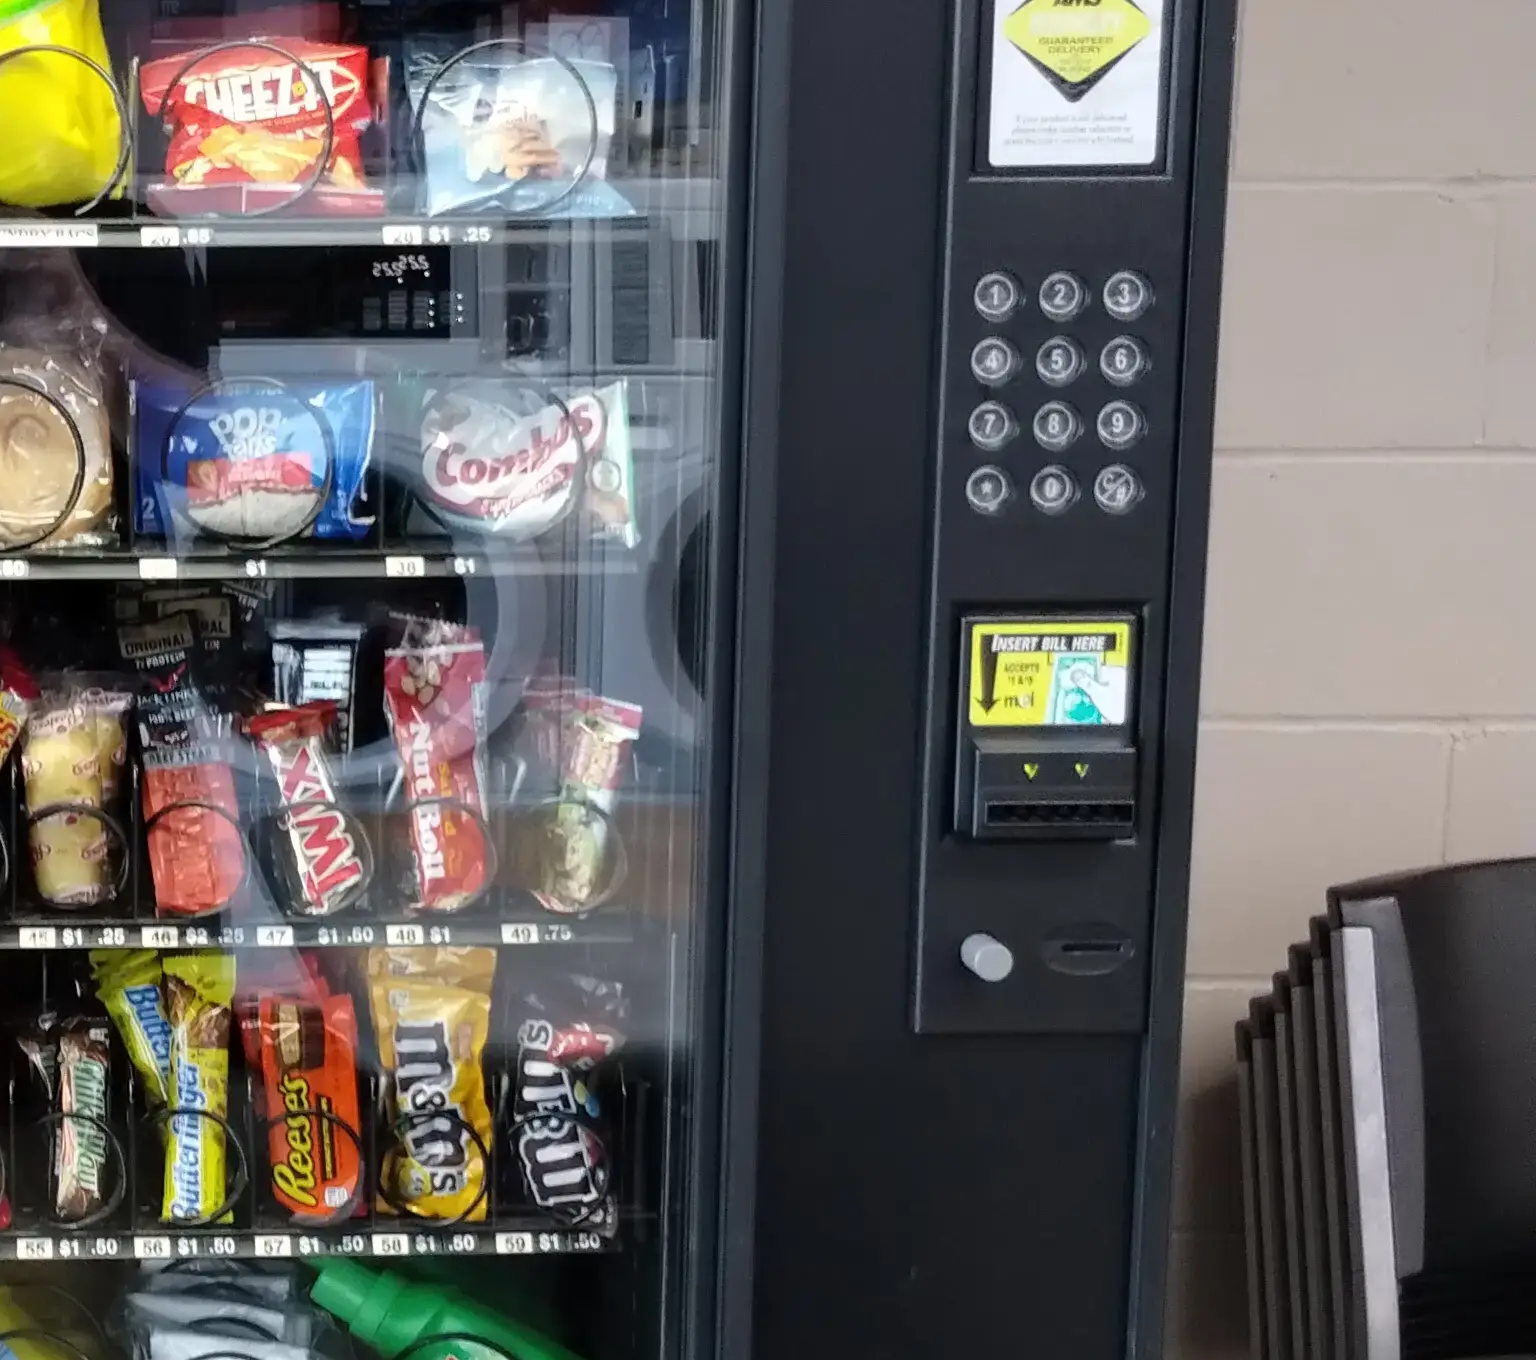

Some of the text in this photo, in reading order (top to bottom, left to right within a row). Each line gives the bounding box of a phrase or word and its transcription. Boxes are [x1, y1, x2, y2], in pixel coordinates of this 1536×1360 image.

[991, 634, 1107, 652] INSERT BILL HERE
